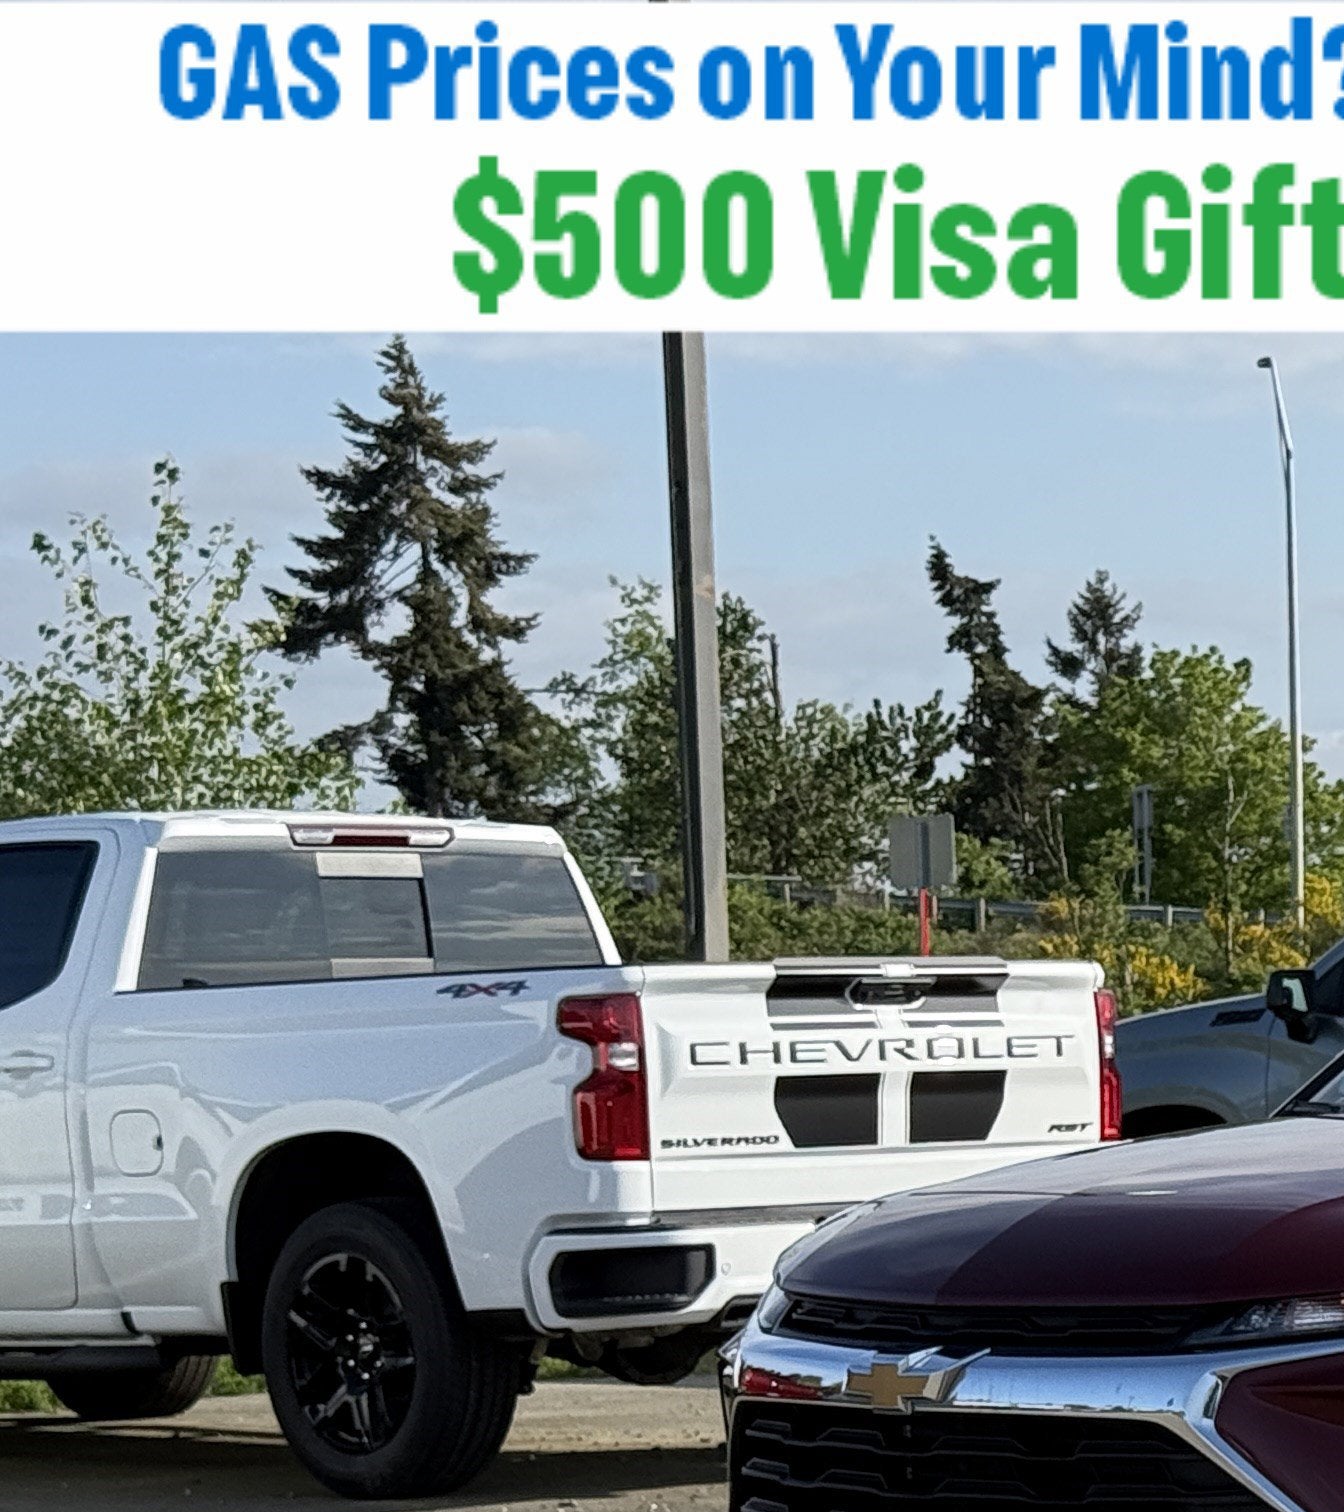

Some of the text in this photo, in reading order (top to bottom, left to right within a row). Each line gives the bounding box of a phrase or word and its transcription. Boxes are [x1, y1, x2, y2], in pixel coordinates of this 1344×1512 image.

[688, 1034, 1075, 1066] CHEVROLET
[1046, 1122, 1094, 1134] RST
[660, 1134, 780, 1150] SILVERADO
